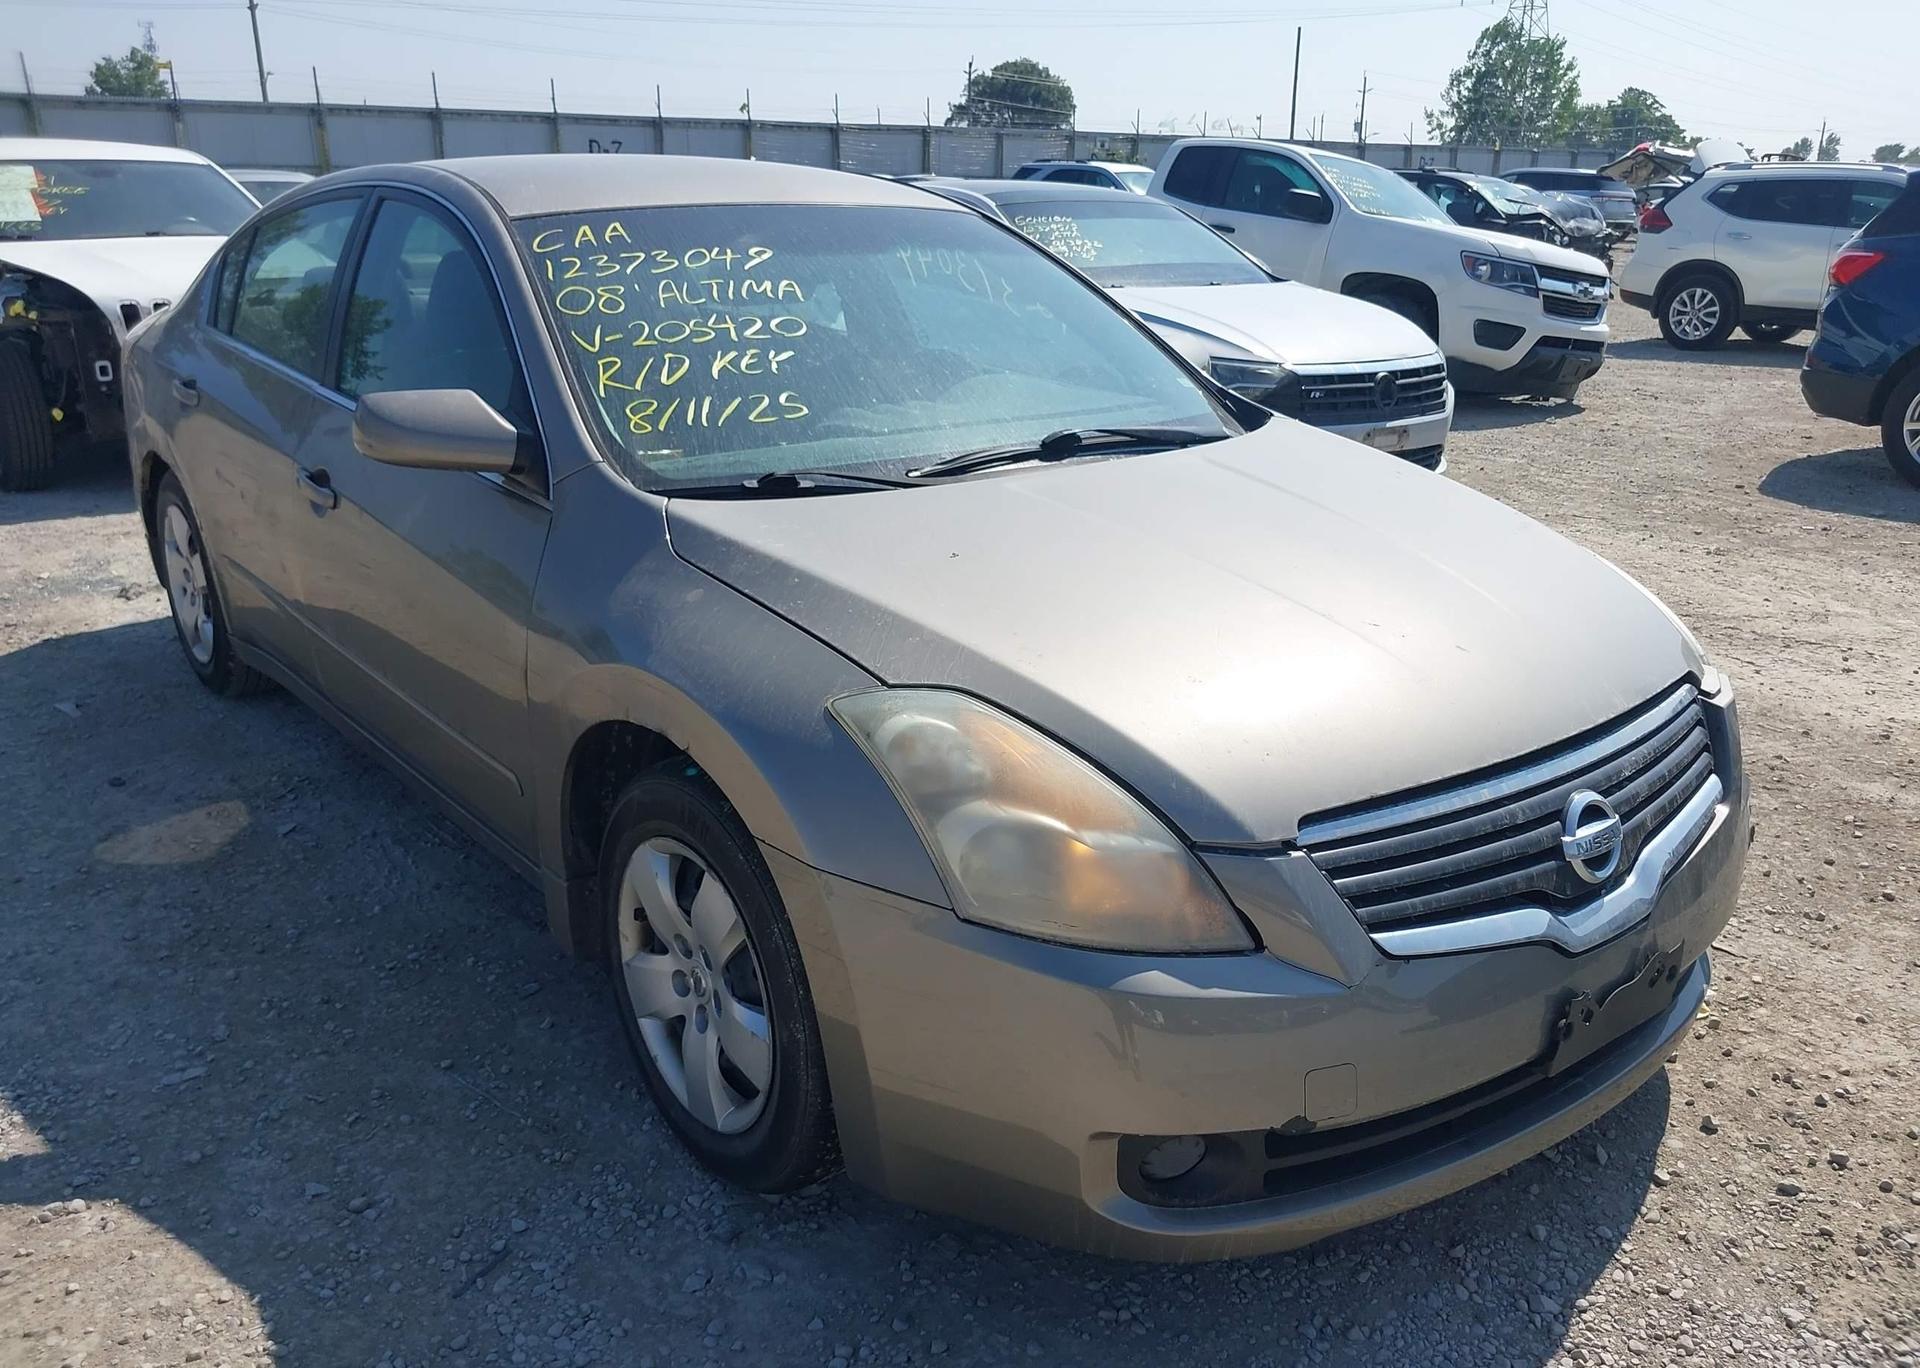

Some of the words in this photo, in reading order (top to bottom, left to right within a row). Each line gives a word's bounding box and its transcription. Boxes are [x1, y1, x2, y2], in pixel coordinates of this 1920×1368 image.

[532, 221, 632, 253] CAA
[545, 246, 774, 281] 12373049
[657, 279, 806, 308] ALTIMA
[571, 313, 808, 354] V-205420
[597, 353, 690, 398] R/D
[711, 350, 796, 380] KEY
[625, 391, 810, 434] 8/11/25
